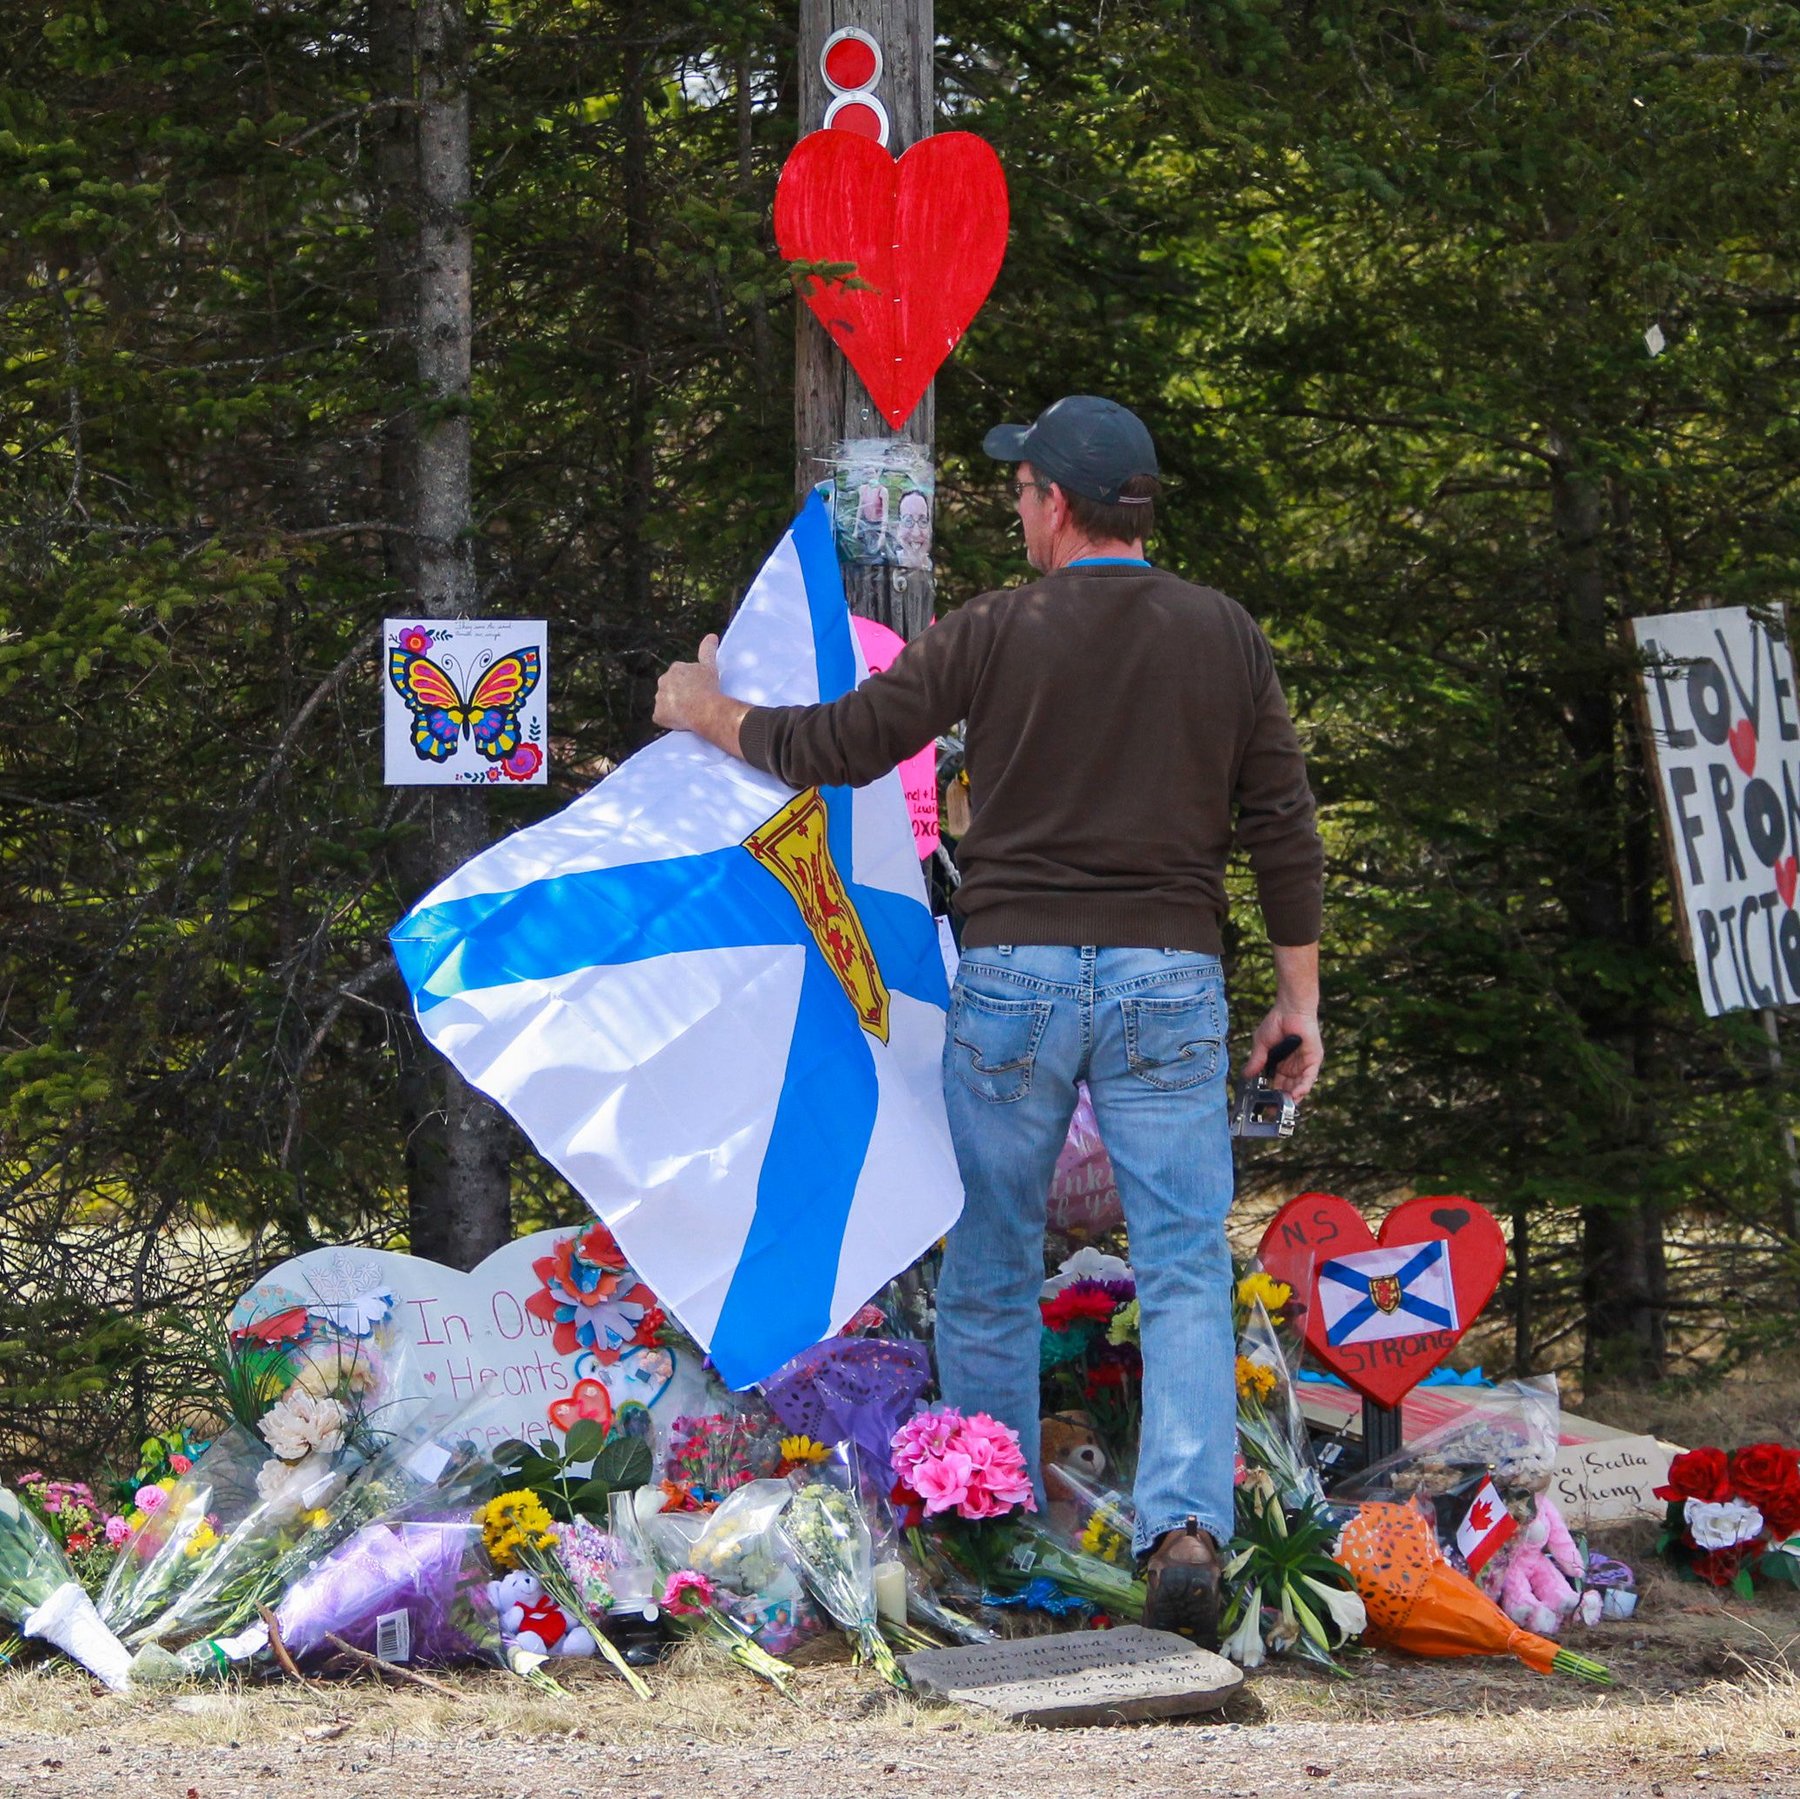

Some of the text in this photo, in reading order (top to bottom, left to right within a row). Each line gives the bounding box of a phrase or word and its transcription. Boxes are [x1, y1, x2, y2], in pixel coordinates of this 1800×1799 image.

[1645, 622, 1799, 748] LOVE
[407, 1298, 472, 1345] In
[446, 1351, 569, 1401] Hearts
[429, 1412, 554, 1448] orever
[1585, 1452, 1648, 1475] Scotia
[1558, 1479, 1643, 1504] Strong
